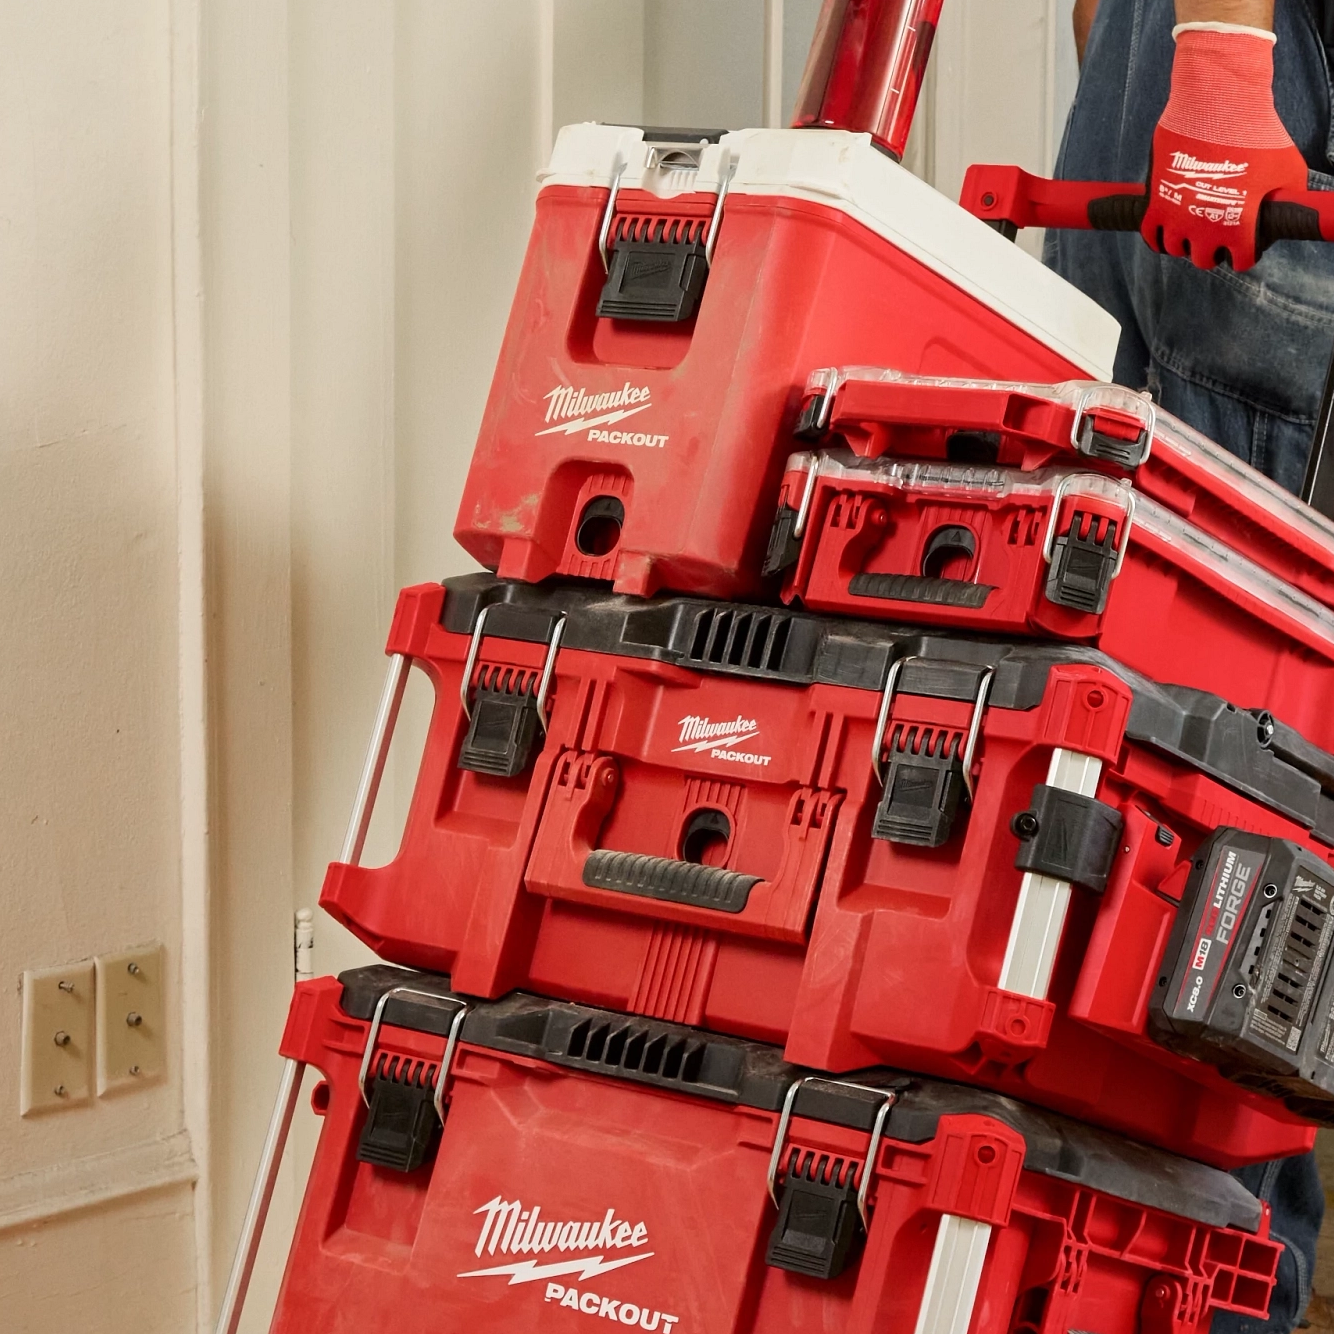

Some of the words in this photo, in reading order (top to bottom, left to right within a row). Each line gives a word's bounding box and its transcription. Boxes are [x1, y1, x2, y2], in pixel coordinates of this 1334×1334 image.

[1169, 150, 1246, 172] Milwaukee
[1213, 185, 1240, 195] LEVEL
[543, 381, 651, 424] Milwaukee
[587, 429, 669, 448] PACKOUT
[677, 714, 757, 743] Milwaukee
[710, 748, 772, 766] PACKOUT
[1216, 862, 1251, 945] FORGE
[1195, 940, 1210, 968] M18
[1187, 975, 1203, 1013] XC8.0
[473, 1194, 649, 1259] Milwaukee
